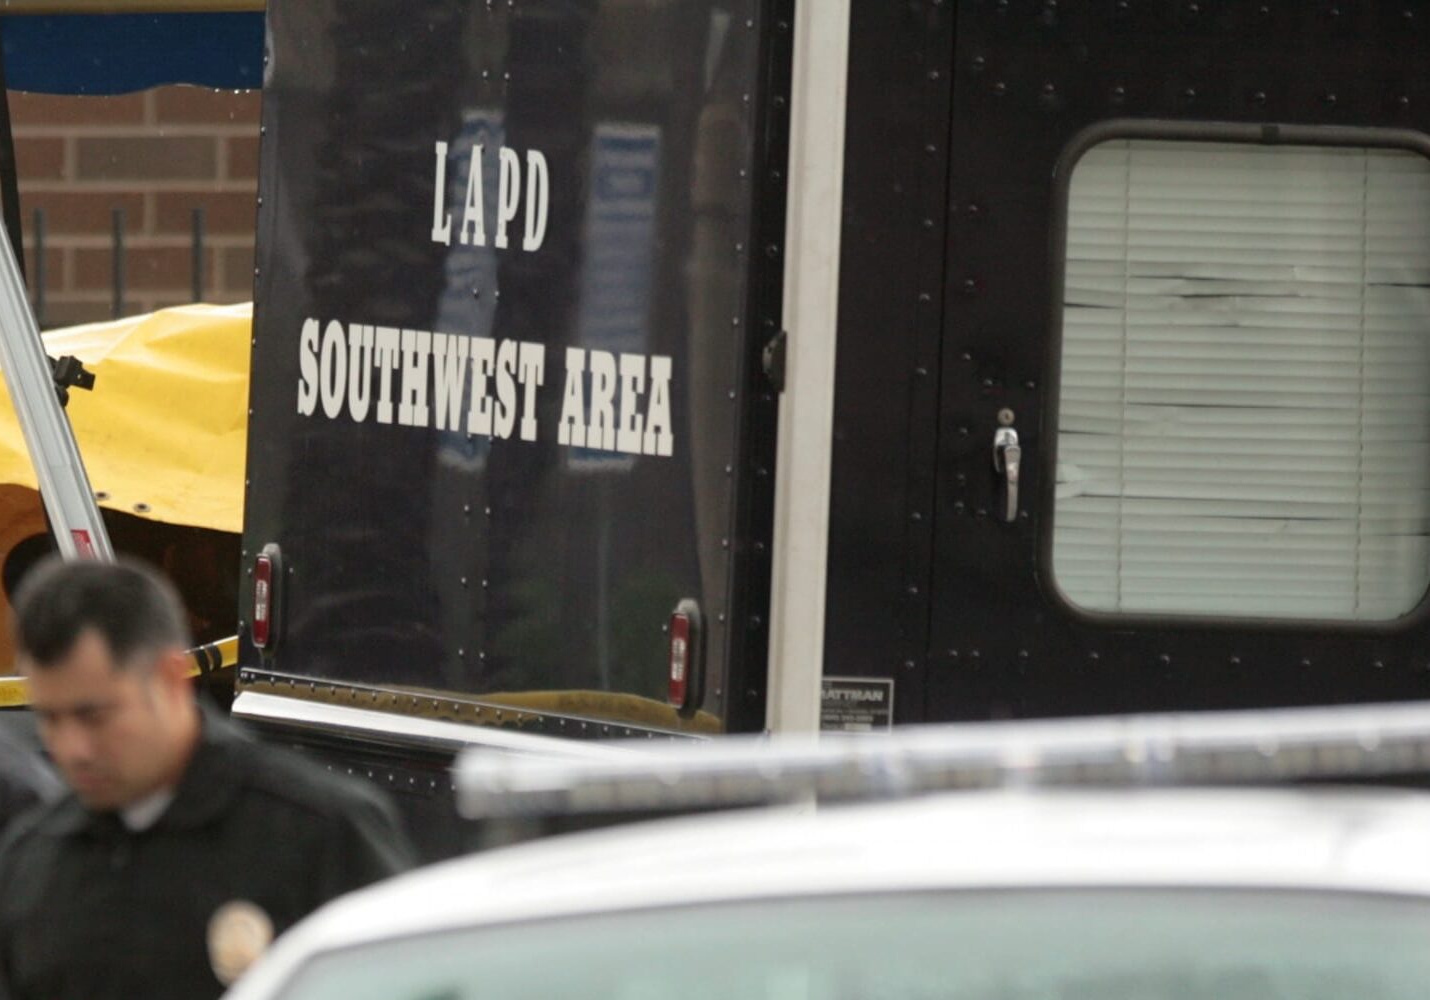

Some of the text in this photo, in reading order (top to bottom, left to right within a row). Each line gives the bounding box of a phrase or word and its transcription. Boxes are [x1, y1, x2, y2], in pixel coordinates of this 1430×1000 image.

[431, 141, 550, 252] LAPD
[298, 317, 674, 457] SOUTHWEST AREA
